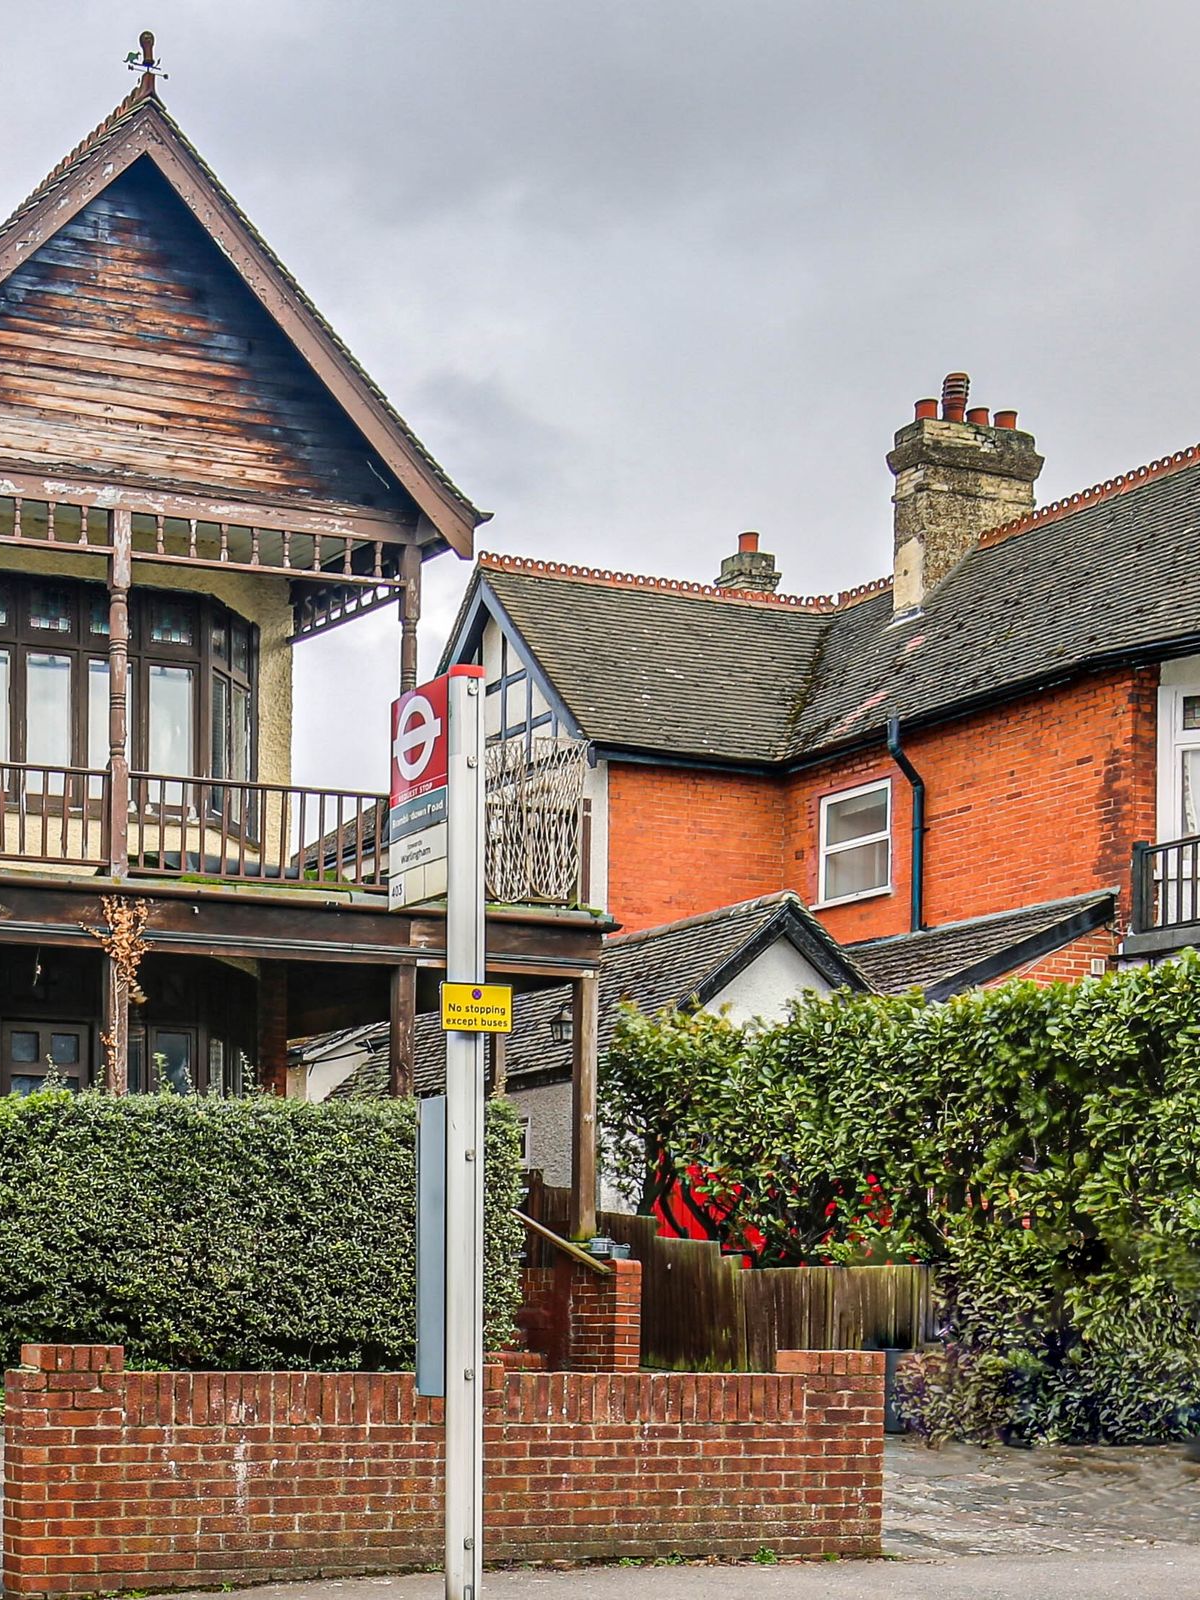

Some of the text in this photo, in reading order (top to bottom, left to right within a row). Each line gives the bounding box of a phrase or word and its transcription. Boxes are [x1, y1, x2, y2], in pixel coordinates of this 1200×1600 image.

[419, 782, 433, 794] STOP
[400, 847, 431, 864] Warlingham
[391, 883, 403, 898] 403
[448, 1003, 506, 1015] No stopping
[446, 1017, 508, 1027] except buses
